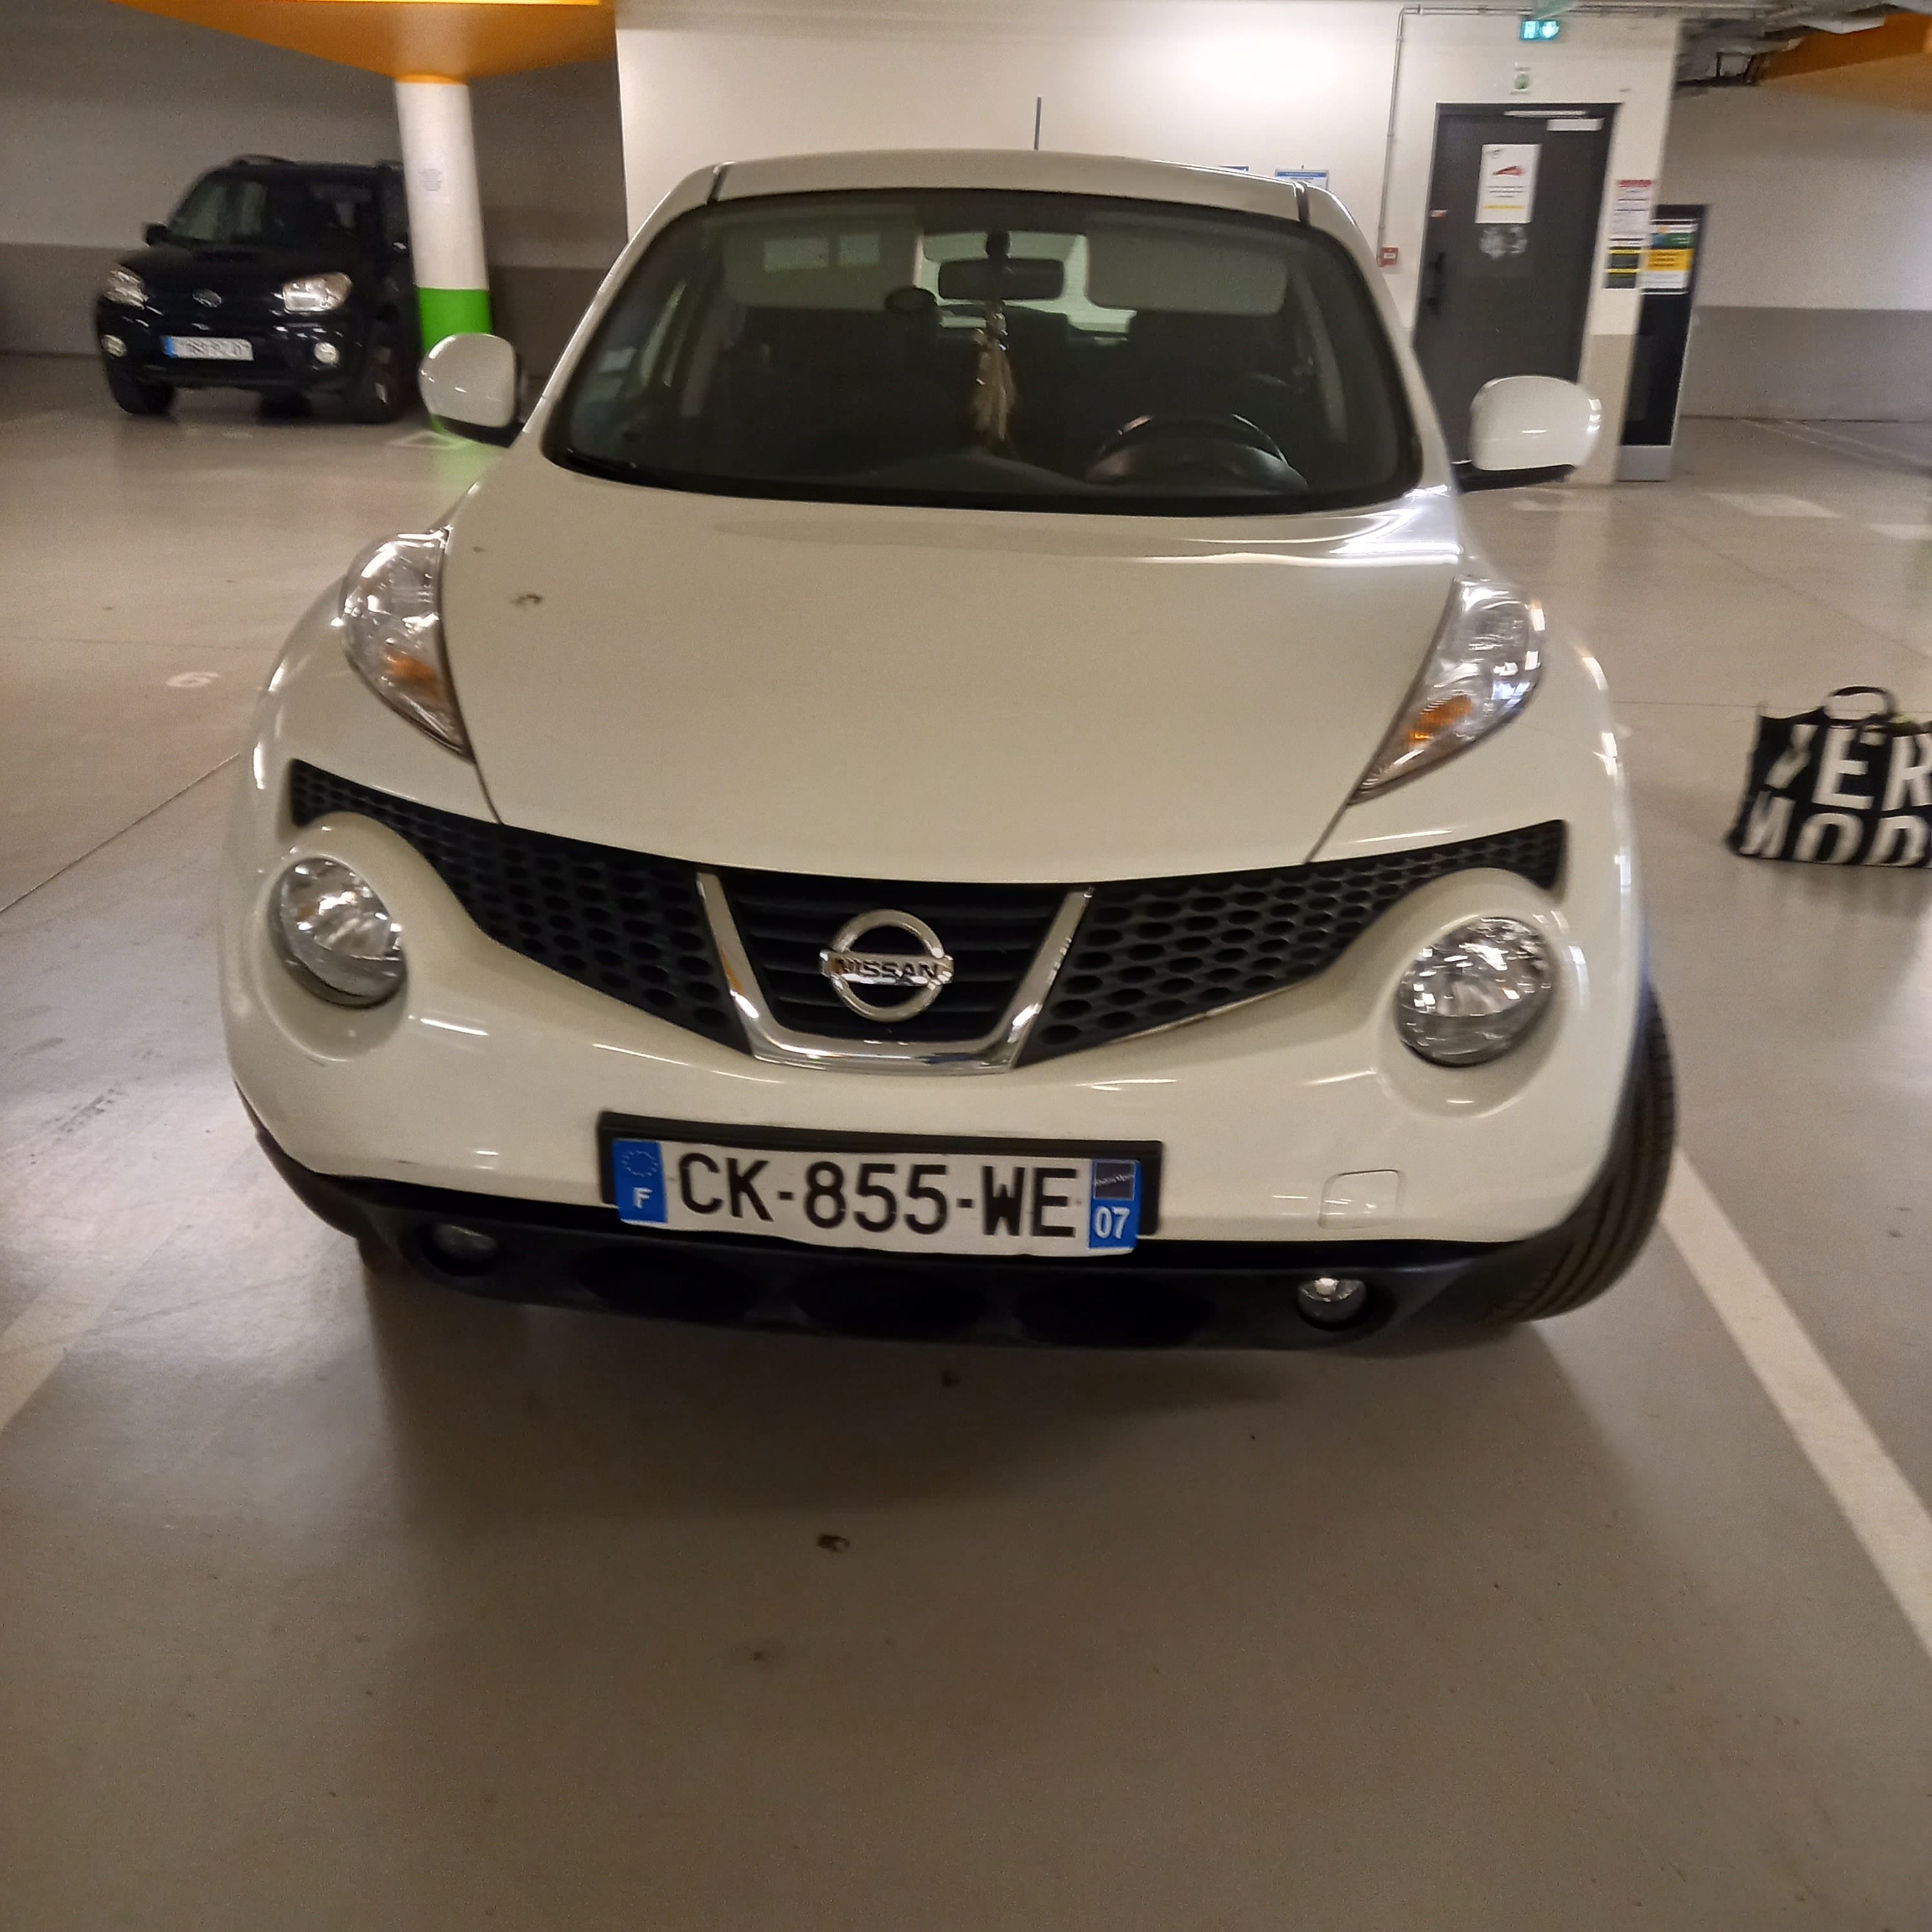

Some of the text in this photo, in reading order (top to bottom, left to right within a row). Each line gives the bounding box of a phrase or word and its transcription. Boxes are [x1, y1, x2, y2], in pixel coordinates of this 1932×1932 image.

[834, 956, 938, 980] NISSAN
[632, 1186, 653, 1209] F
[678, 1152, 1078, 1238] CK-855-WE
[1094, 1205, 1131, 1240] 07
